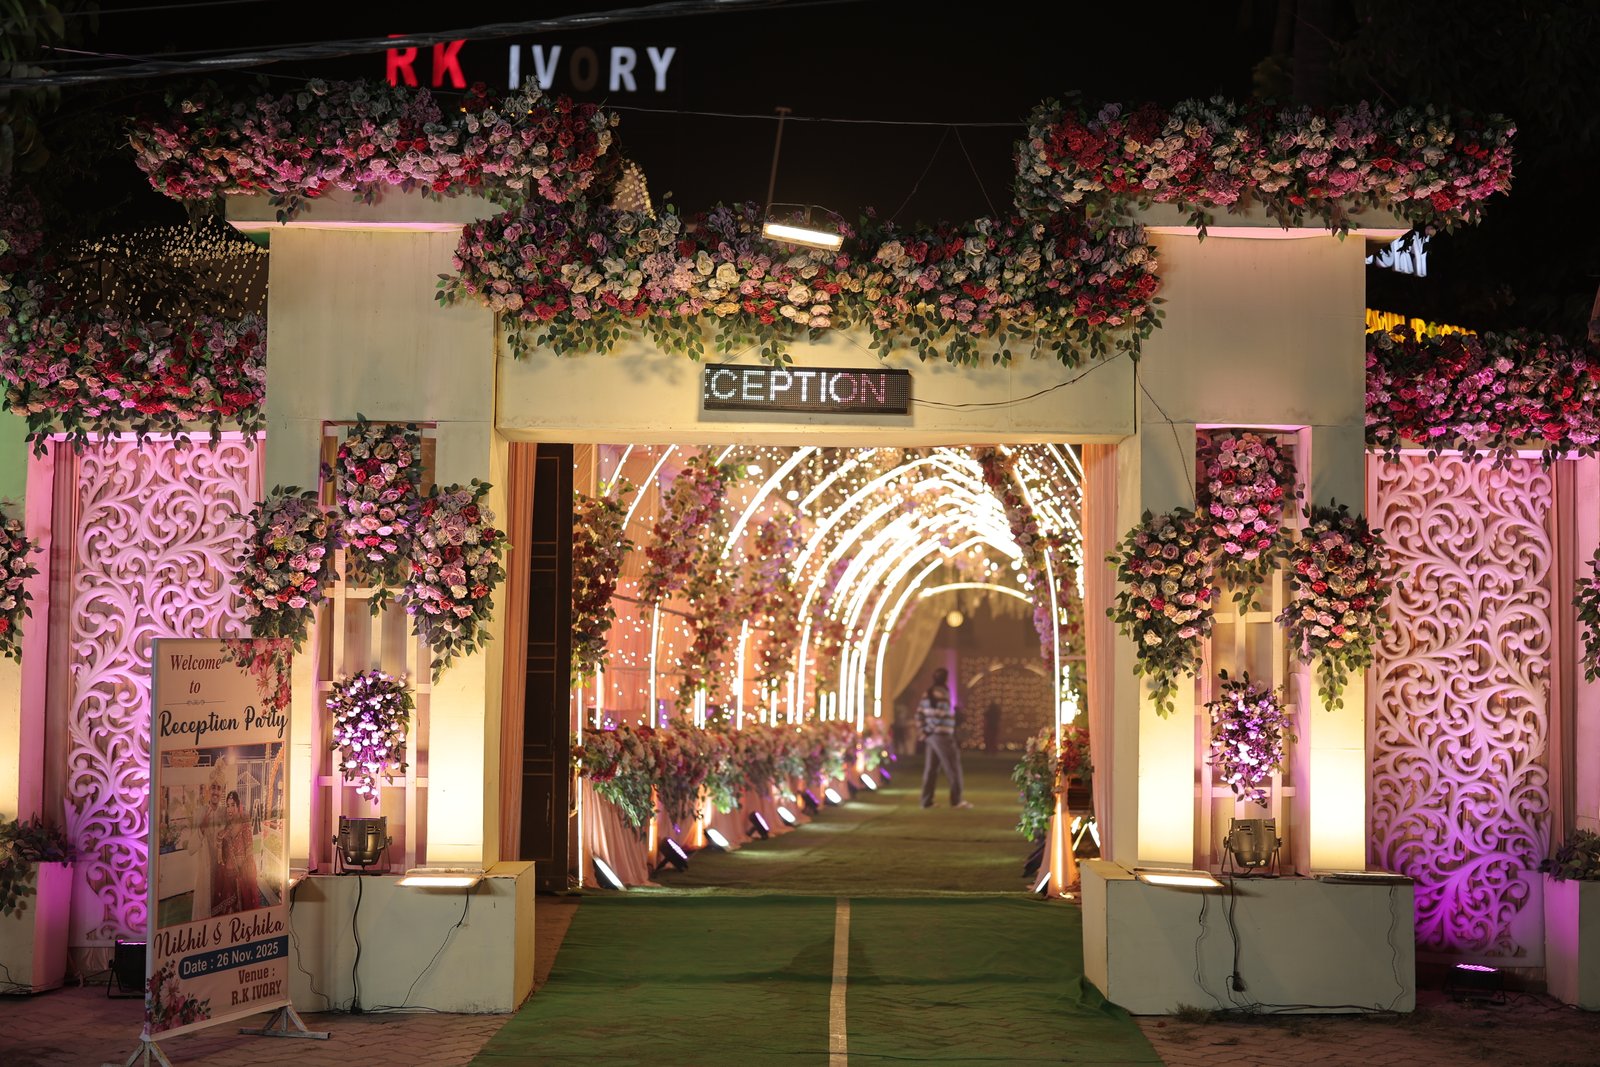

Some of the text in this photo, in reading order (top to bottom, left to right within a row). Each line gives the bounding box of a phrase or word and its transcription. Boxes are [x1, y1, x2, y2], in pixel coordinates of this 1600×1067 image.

[385, 34, 677, 92] RK IVORY
[705, 368, 886, 404] CEPTION
[170, 654, 222, 670] Welcome
[189, 680, 200, 694] to
[159, 706, 288, 745] Reception Party
[154, 912, 284, 959] Nikhil & Rishika
[183, 961, 207, 975] Date
[216, 954, 229, 967] 26
[231, 950, 253, 964] Nov.
[256, 942, 279, 959] 2025
[238, 967, 269, 985] Venue
[231, 980, 282, 1006] R.K IVORY
